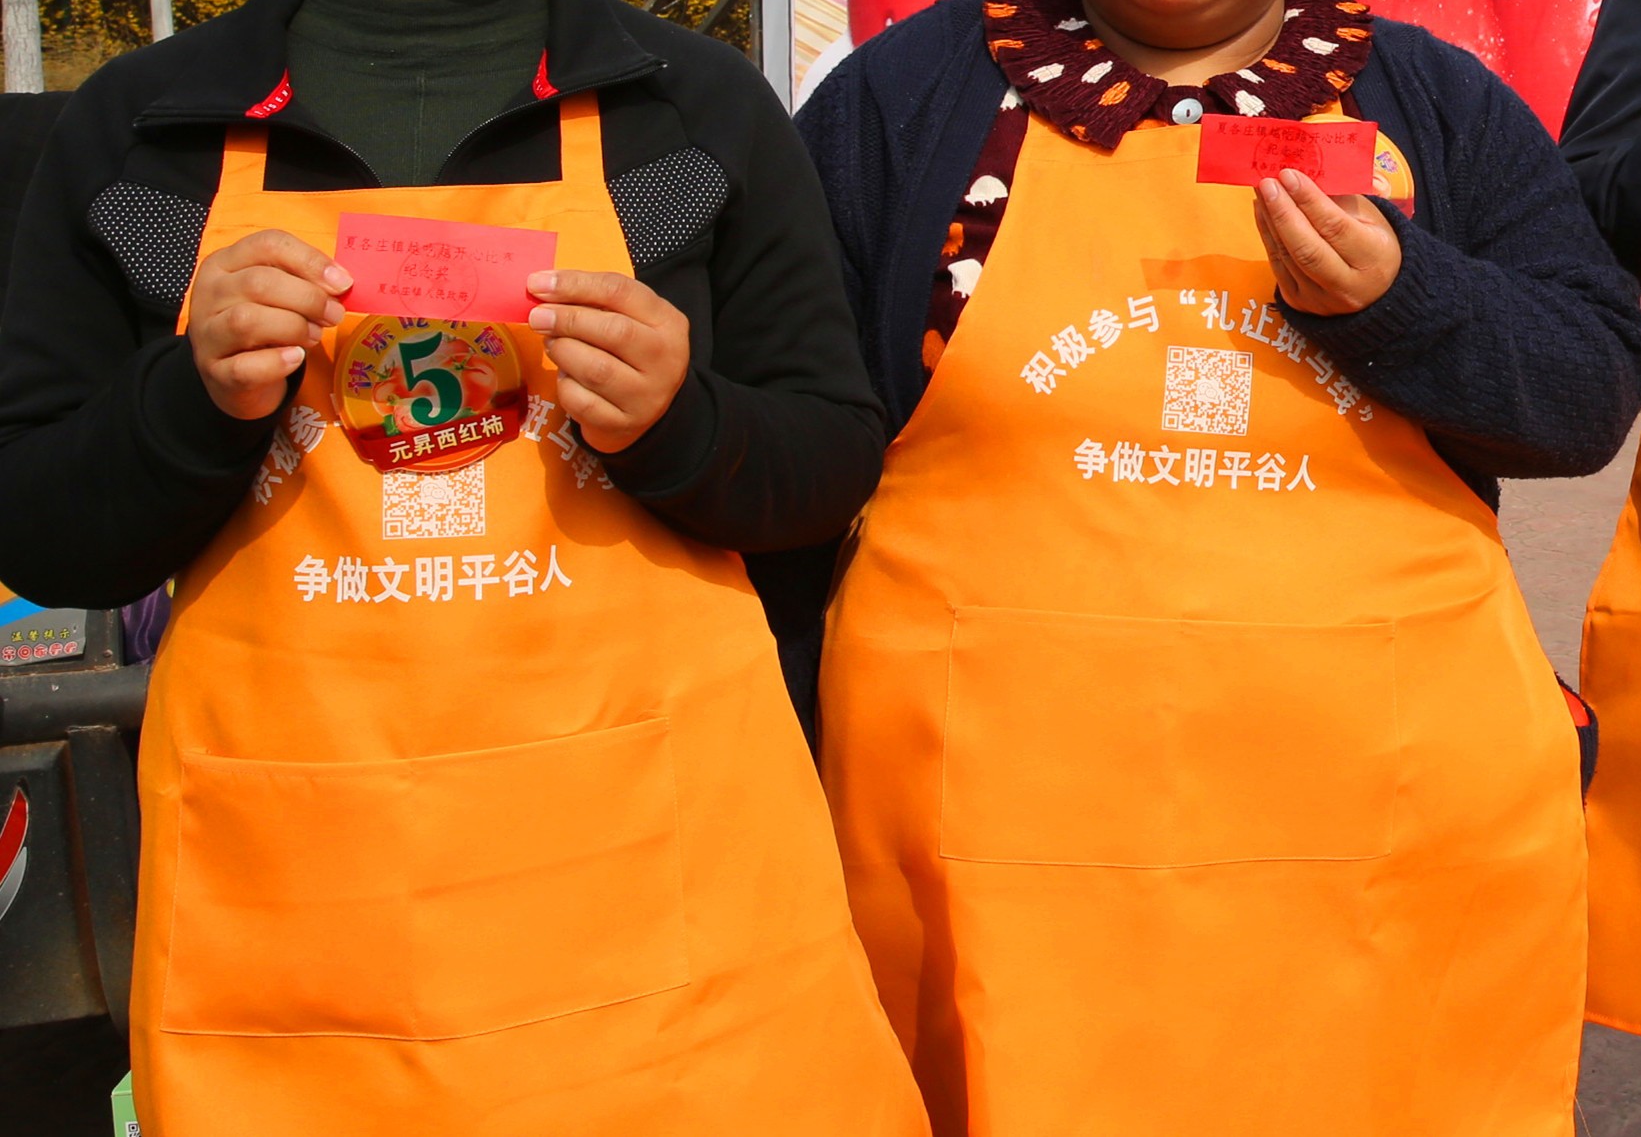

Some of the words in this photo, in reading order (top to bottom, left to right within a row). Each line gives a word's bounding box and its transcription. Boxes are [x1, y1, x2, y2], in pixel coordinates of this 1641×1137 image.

[398, 331, 463, 426] 5
[389, 414, 504, 463] 元昇西红柿
[1073, 438, 1316, 492] 争做文明平谷人
[294, 544, 573, 604] 争做文明平谷人
